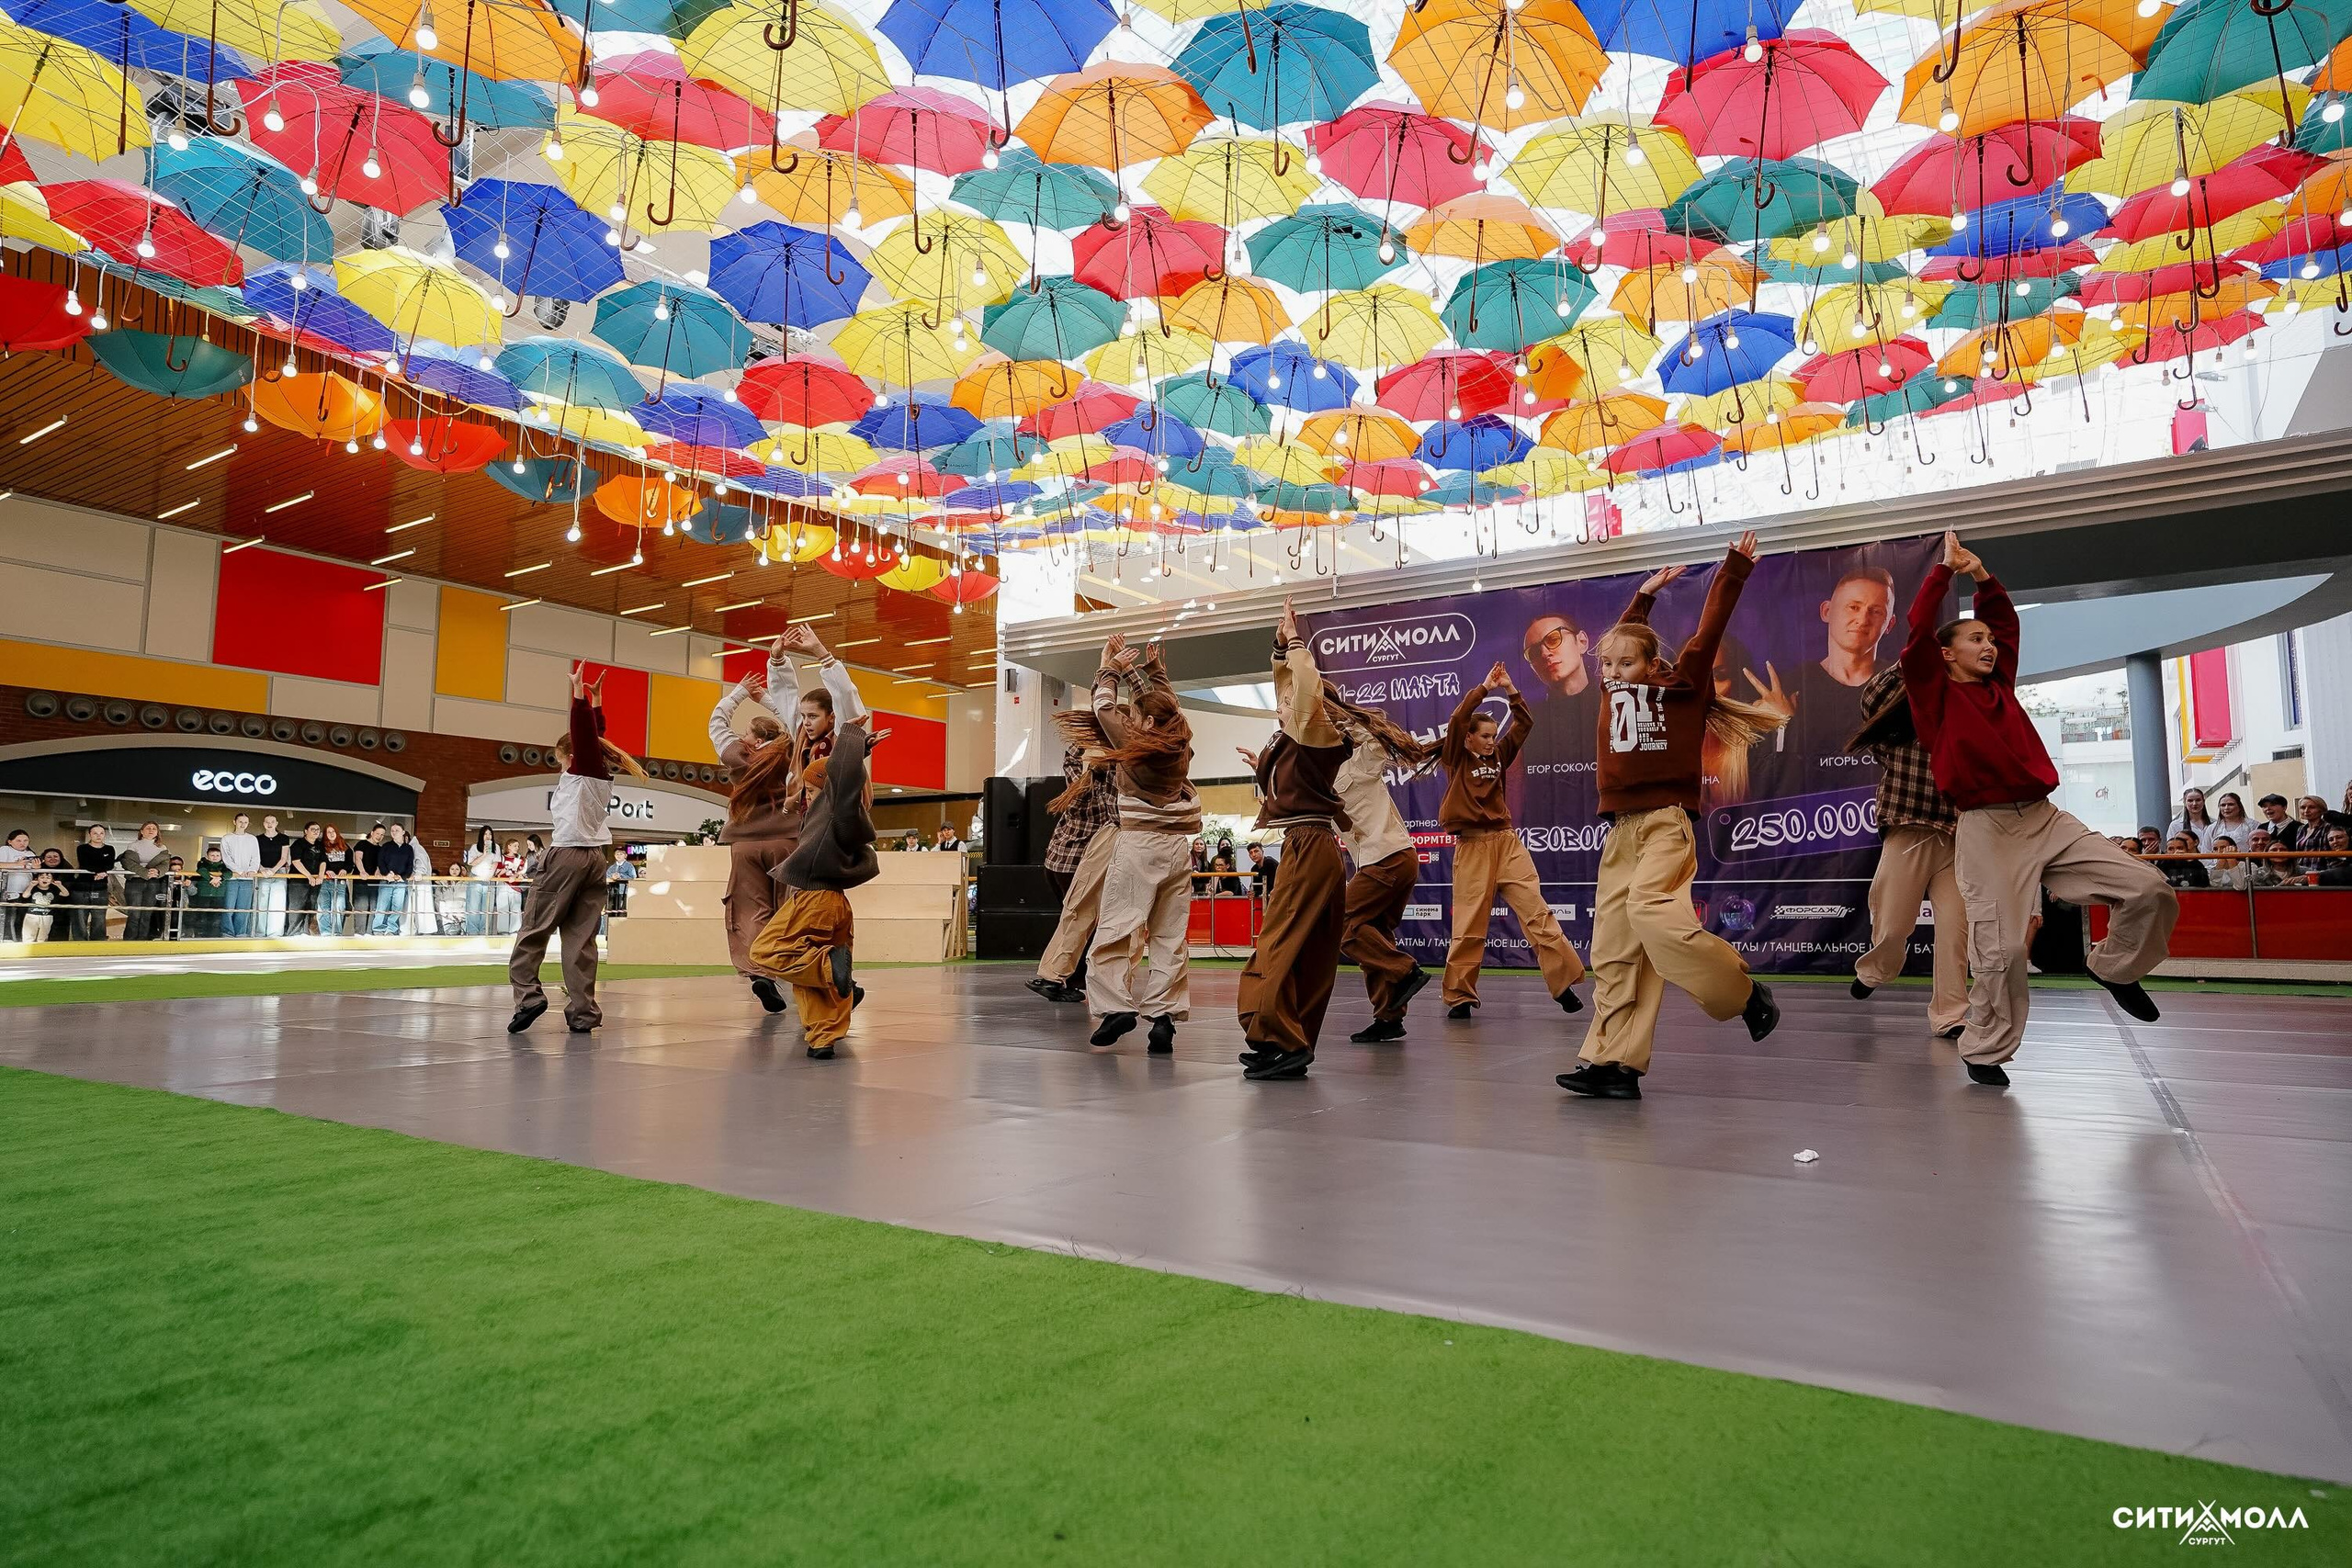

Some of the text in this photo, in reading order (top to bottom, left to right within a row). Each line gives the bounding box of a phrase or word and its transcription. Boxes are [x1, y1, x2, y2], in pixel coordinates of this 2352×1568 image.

[1320, 624, 1461, 655] СИТИ МОЛЛ
[1372, 654, 1399, 662] СУРГУТ
[1391, 672, 1460, 701] МАРТА
[1639, 742, 1668, 751] JOURNEY
[1527, 761, 1598, 774] ЕГОР СОКОЛО
[1820, 756, 1859, 767] ИГОРЬ
[192, 770, 277, 795] ecco
[1516, 822, 1611, 852] ИЗОВОЙ
[1770, 942, 1866, 953] ТАНЦЕВАЛЬНОЕ
